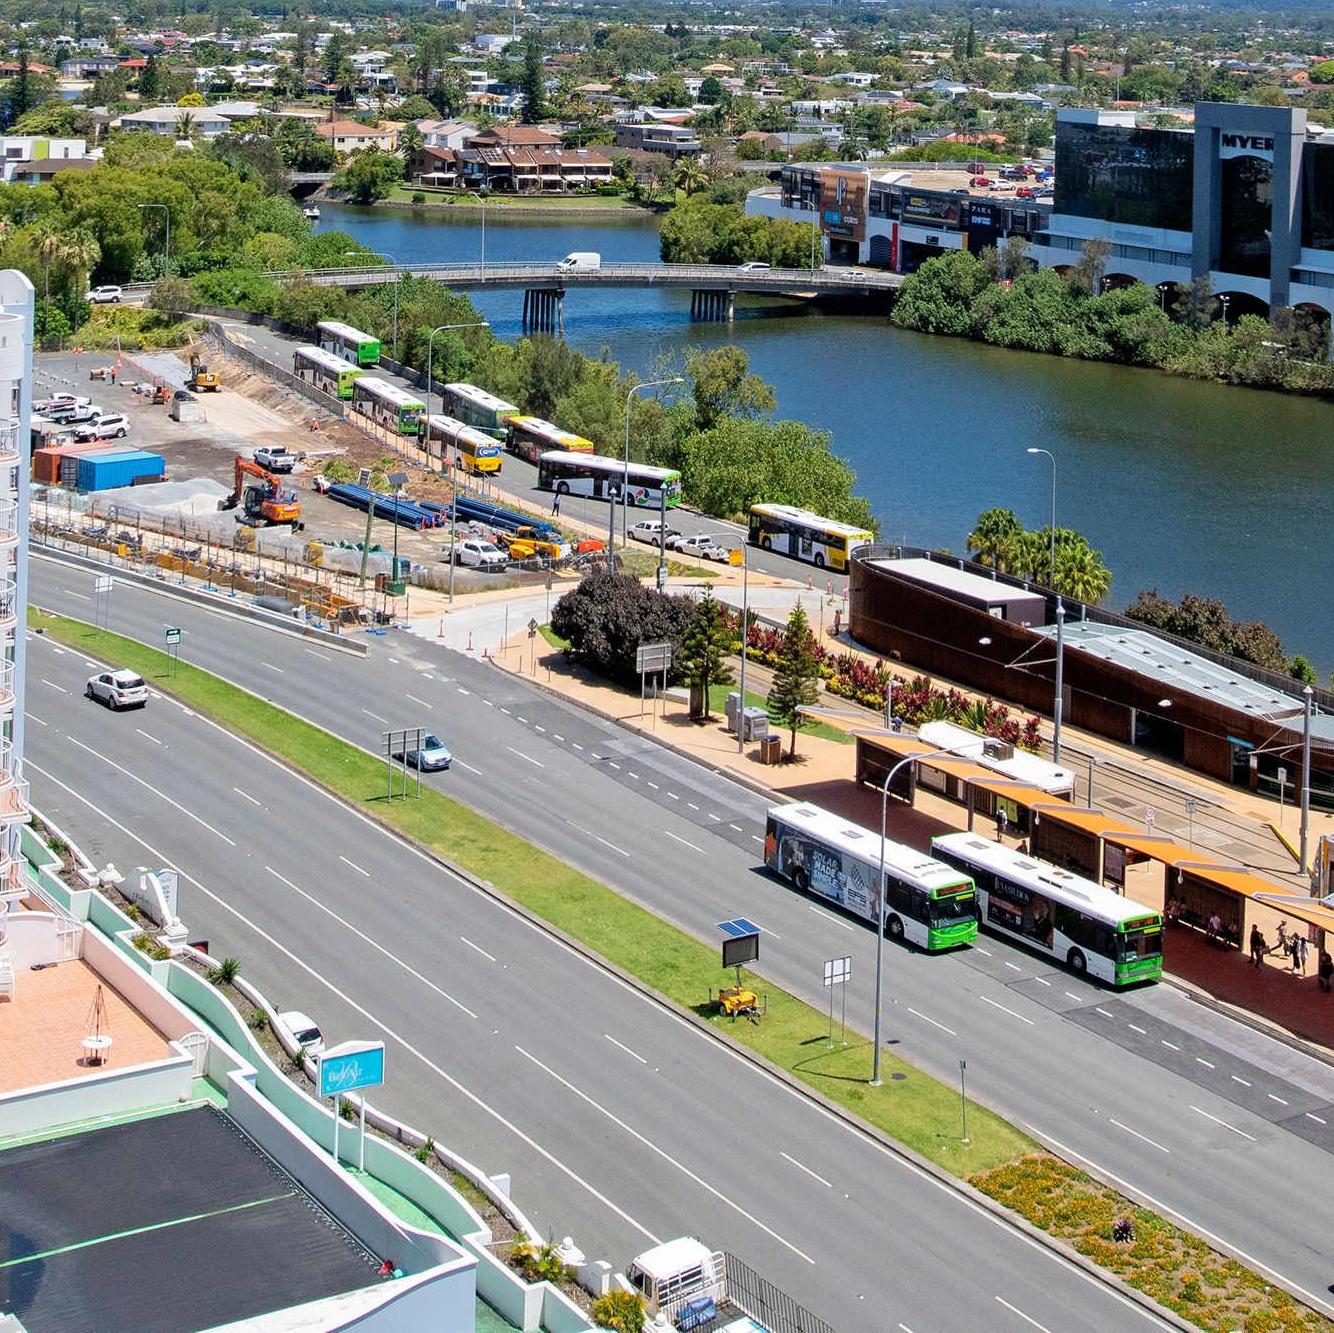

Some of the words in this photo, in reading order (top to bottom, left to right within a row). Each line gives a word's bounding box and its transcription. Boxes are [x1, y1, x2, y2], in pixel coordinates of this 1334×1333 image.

[1221, 134, 1274, 151] MYER
[971, 206, 992, 215] ZARA
[814, 860, 837, 878] MADE
